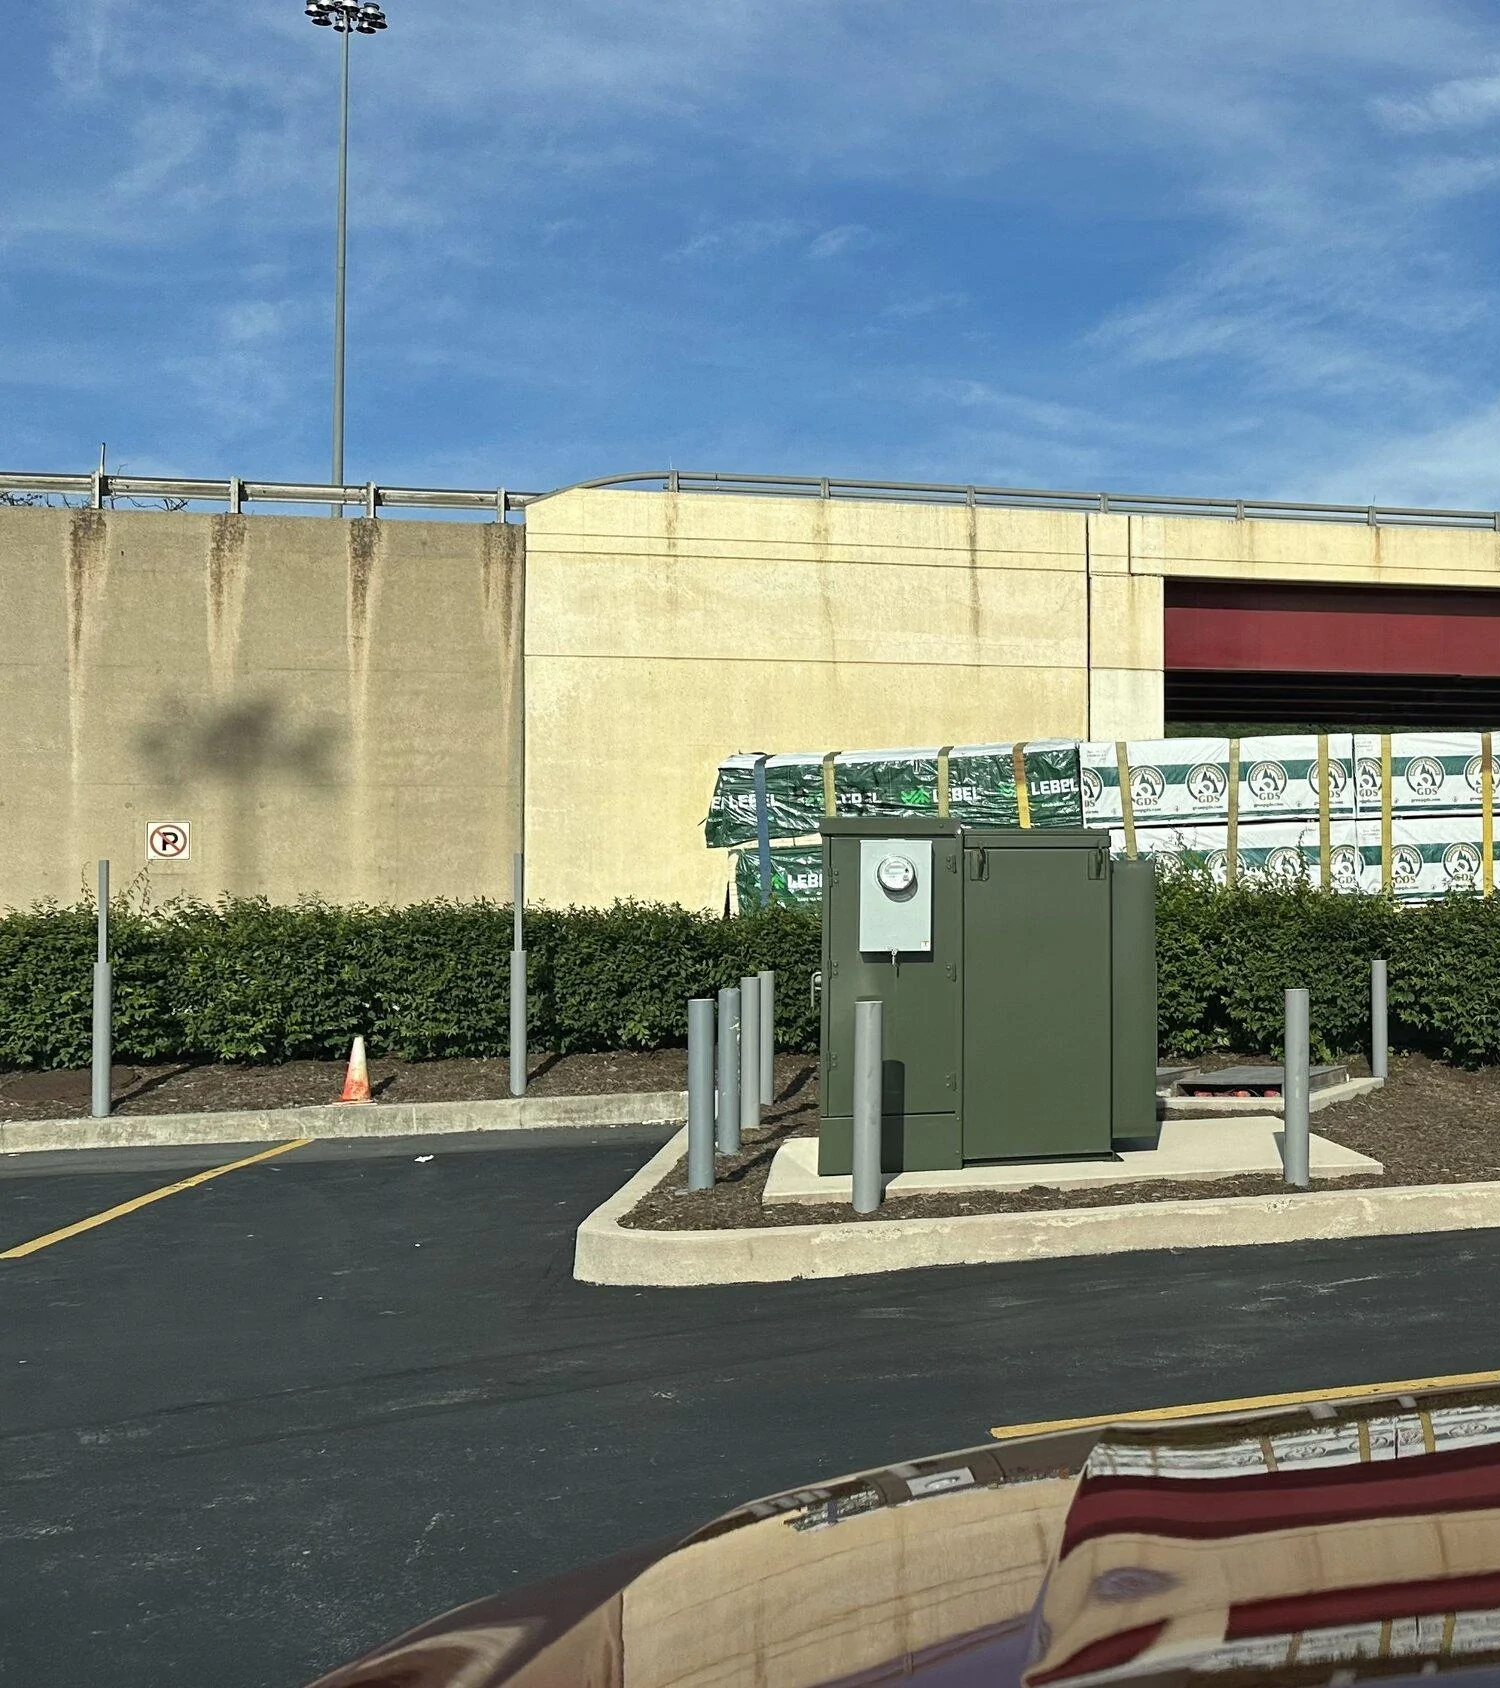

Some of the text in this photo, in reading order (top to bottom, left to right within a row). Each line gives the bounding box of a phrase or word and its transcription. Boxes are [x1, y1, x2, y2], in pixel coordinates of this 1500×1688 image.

[1031, 778, 1079, 795] LEBEL
[1475, 785, 1496, 794] GS
[1329, 790, 1341, 798] DS
[1359, 789, 1379, 797] GDS
[1417, 787, 1438, 796] GDS
[1199, 794, 1220, 803] GDS
[1259, 792, 1281, 801] GDS
[1136, 797, 1159, 806] GDS
[162, 832, 178, 851] P
[787, 873, 823, 889] LEB
